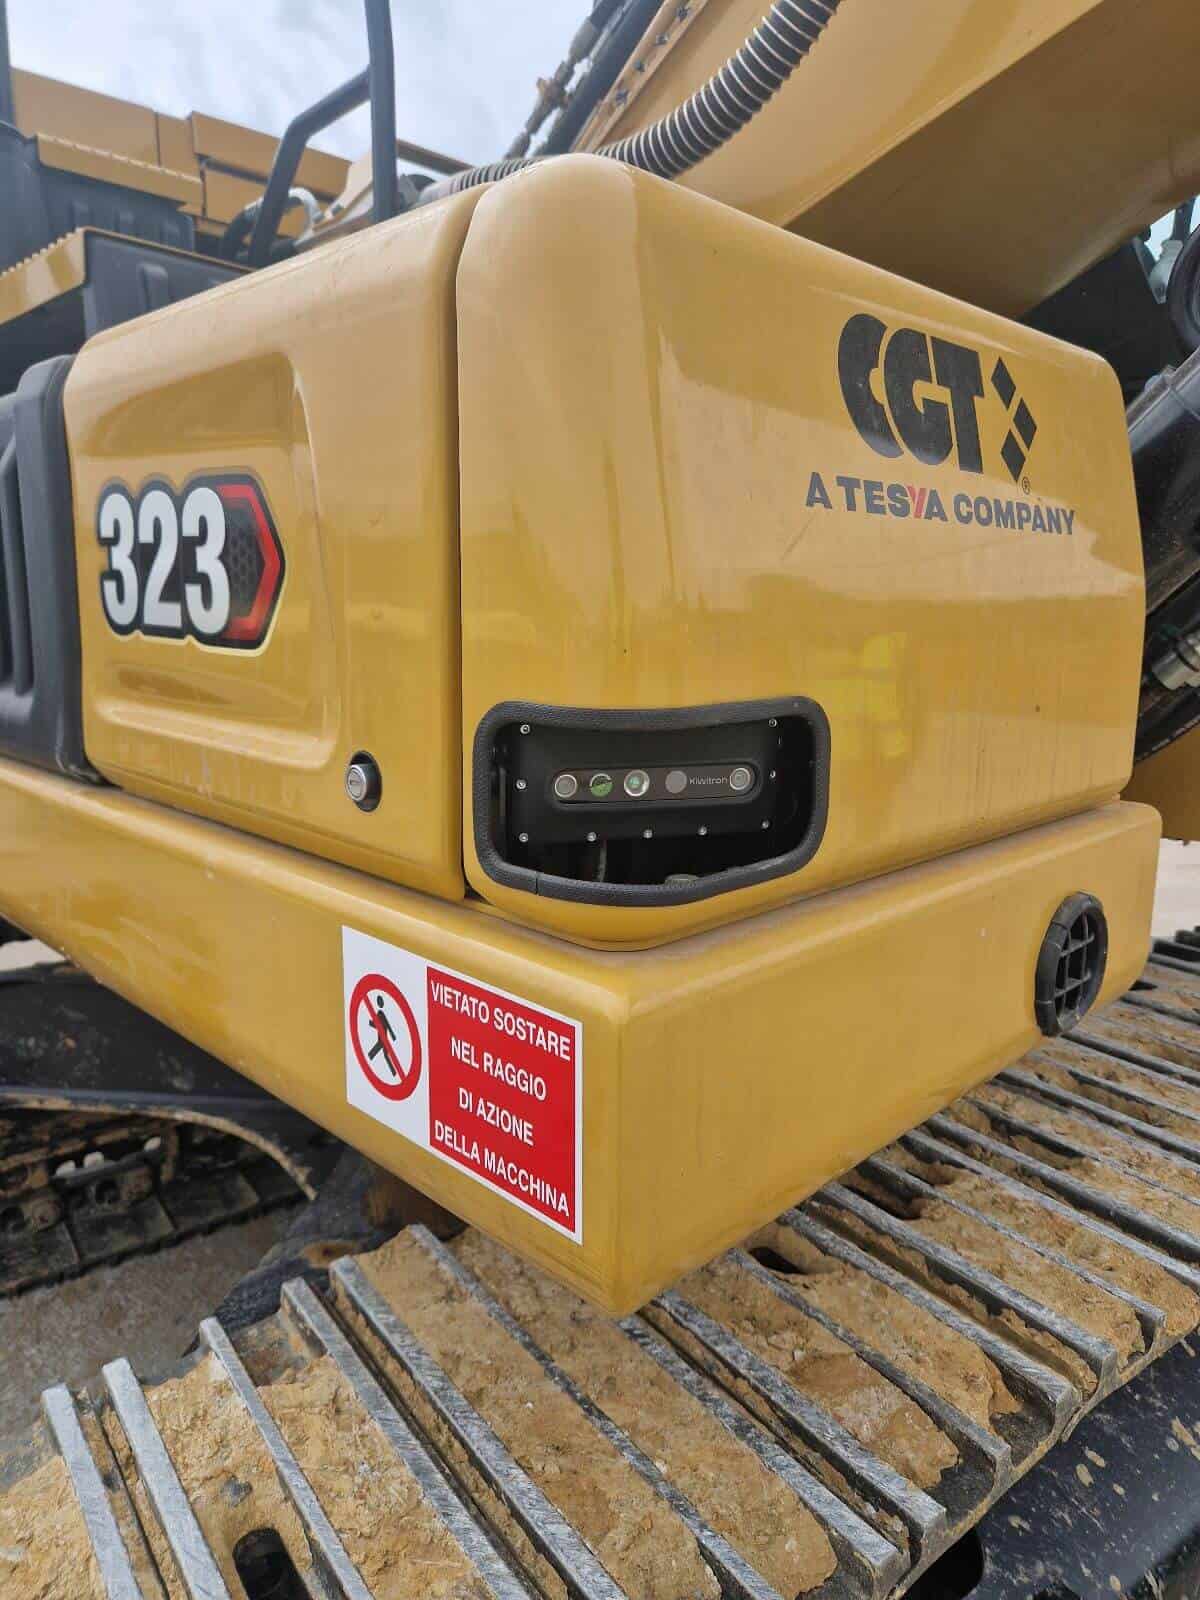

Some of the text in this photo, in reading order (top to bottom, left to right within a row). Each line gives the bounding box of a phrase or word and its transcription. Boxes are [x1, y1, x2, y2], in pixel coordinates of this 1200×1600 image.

[837, 313, 985, 475] CGT
[805, 471, 1075, 535] A TESYA COMPANY
[99, 486, 231, 635] 323
[430, 980, 571, 1061] VIETATO SOSTARE
[450, 1036, 547, 1101] NEL RAGGIO
[458, 1087, 534, 1146] DI AZIONE
[434, 1119, 570, 1217] DELLA MACCHINA
